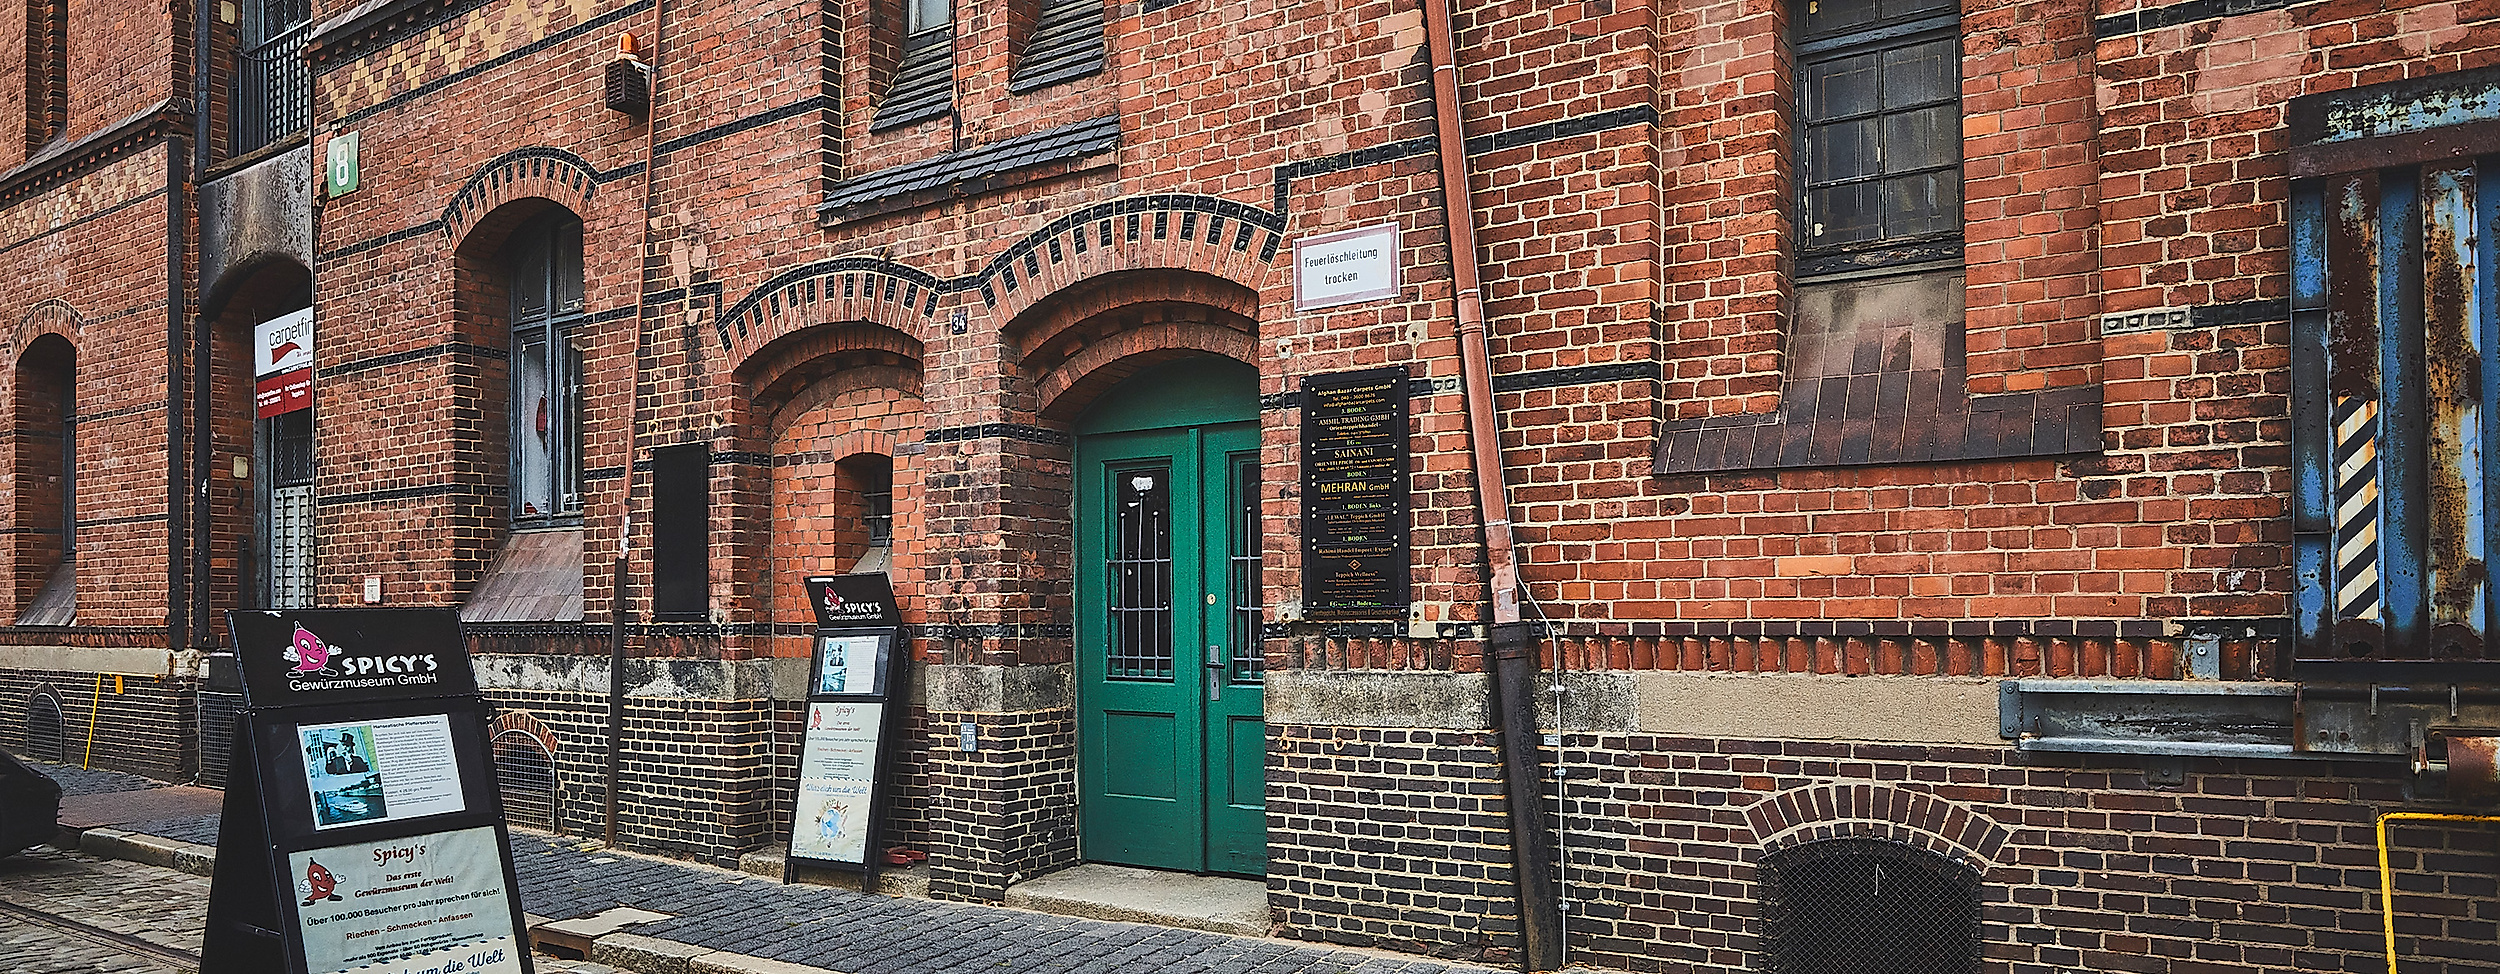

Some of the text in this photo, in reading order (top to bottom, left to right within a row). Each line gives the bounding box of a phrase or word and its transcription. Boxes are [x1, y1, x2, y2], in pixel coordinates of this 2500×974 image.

[336, 142, 350, 187] 8
[1304, 248, 1378, 268] Feuerlöschleitung
[1324, 271, 1358, 285] trocken
[952, 315, 966, 331] 34
[1353, 386, 1374, 394] Carpets
[1341, 415, 1369, 424] TRADING
[1370, 414, 1390, 422] GMBH
[1334, 448, 1374, 459] SAINANI
[1320, 481, 1390, 494] MEHRAN GmbH
[844, 602, 881, 614] SPICY'S
[342, 653, 438, 676] SPICY'S
[289, 673, 437, 691] Gewürzmuseum GmbH
[386, 870, 422, 882] Das erste
[354, 876, 454, 898] Gewürzmuseum der Welt!
[306, 887, 501, 927] Über 100.000 Besucher pro Jahr sprechen für sich!
[346, 928, 380, 941] Riechen
[386, 918, 433, 933] Schmecken
[438, 911, 474, 924] Anfassen
[440, 959, 465, 974] die
[467, 948, 506, 968] Welt
